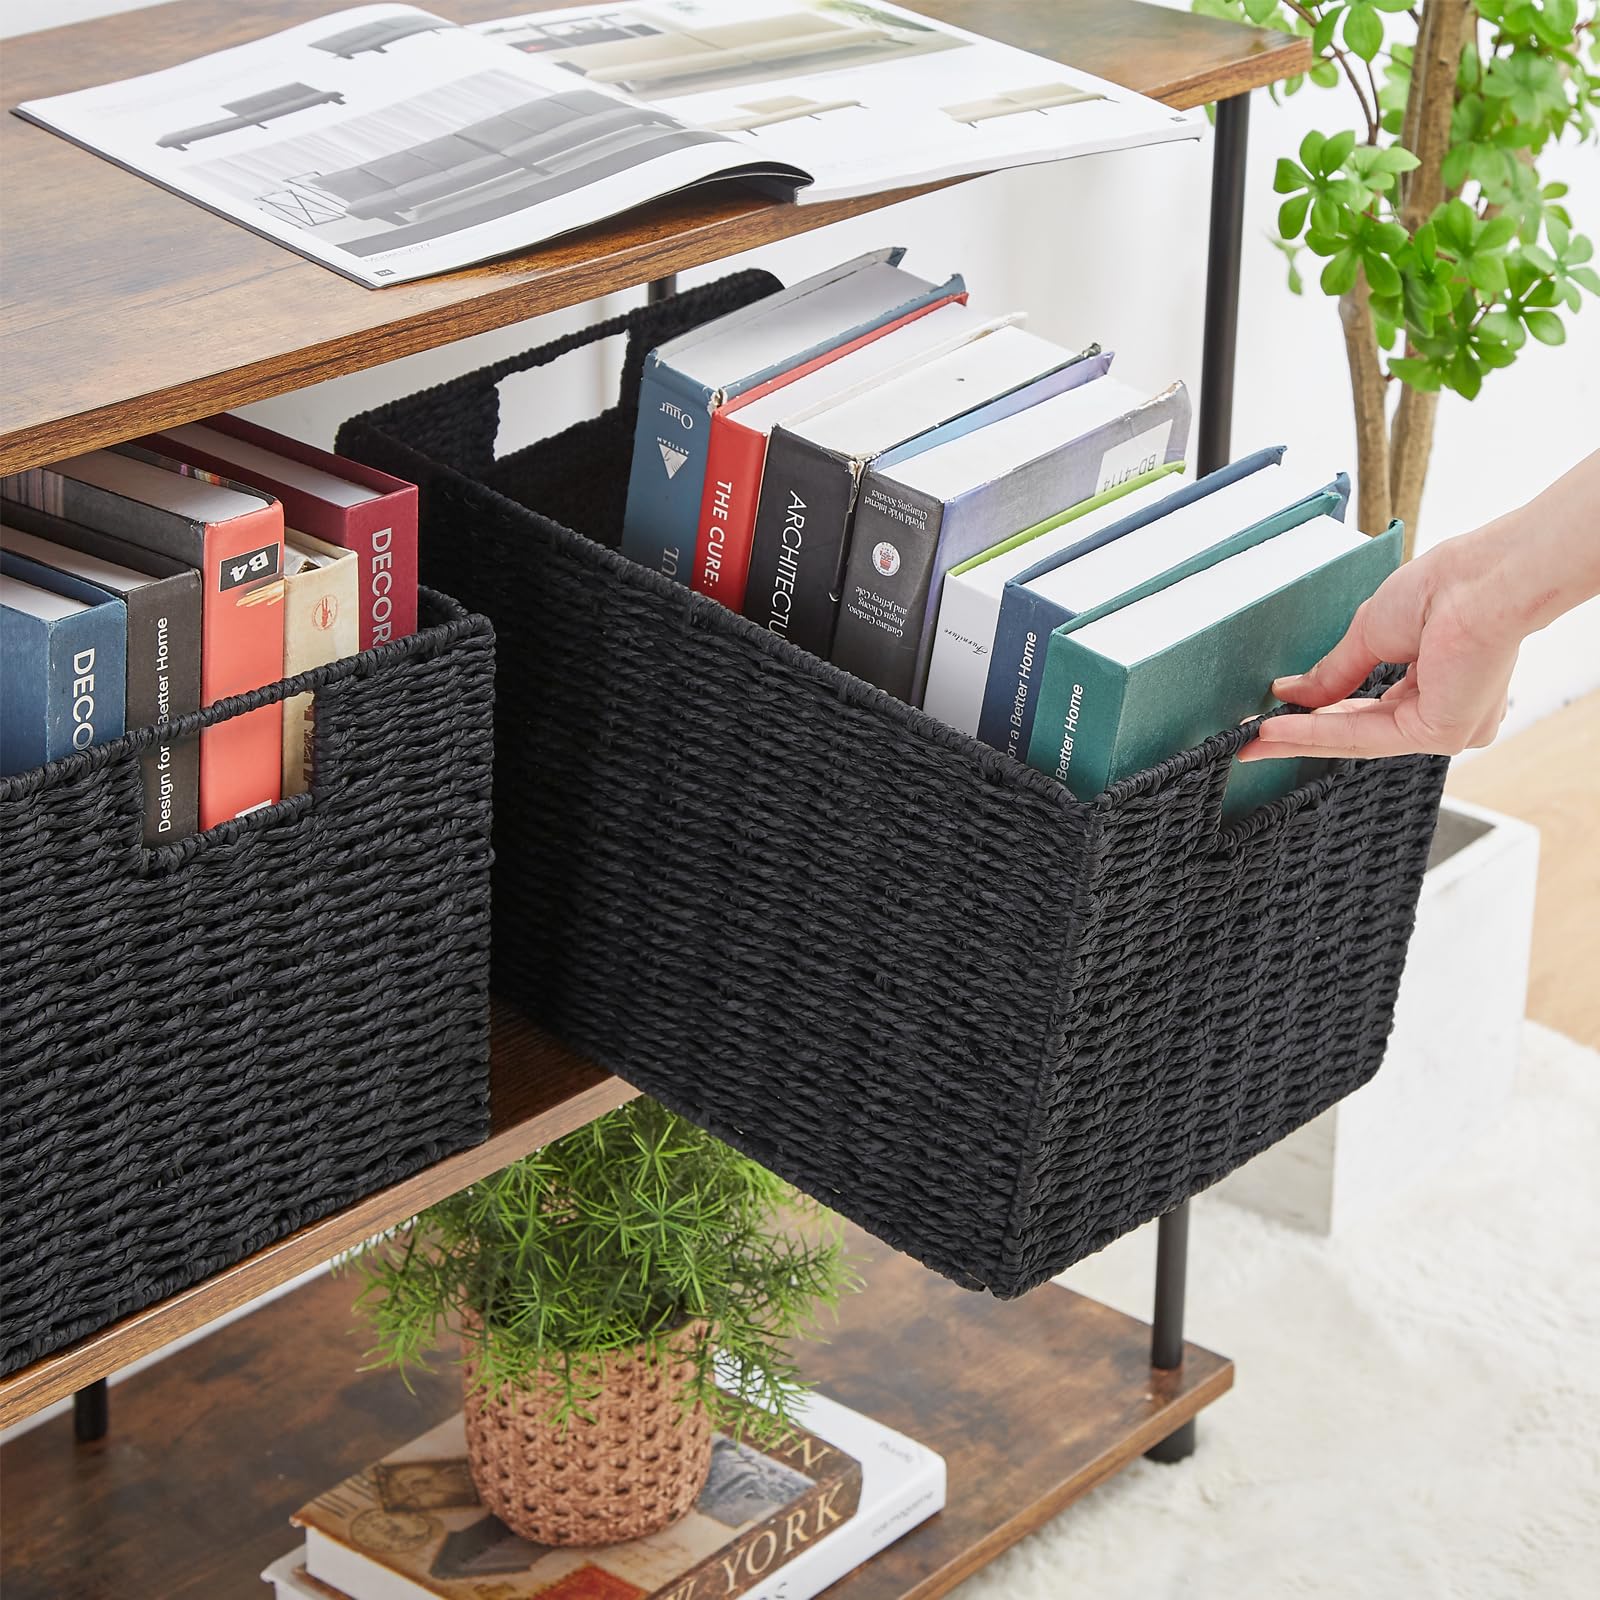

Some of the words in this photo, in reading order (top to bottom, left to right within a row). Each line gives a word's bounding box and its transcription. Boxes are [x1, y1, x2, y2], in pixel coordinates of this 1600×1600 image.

[660, 402, 693, 429] Ouur
[656, 436, 689, 455] ARTISAN
[713, 480, 732, 521] THE
[888, 507, 904, 522] Wide
[897, 499, 928, 521] Changing
[905, 514, 925, 530] World
[230, 551, 269, 582] B4
[703, 526, 725, 587] CURE:
[768, 489, 807, 639] ARCHITECTU
[372, 527, 393, 645] DECOR
[855, 586, 871, 600] Cole
[871, 592, 895, 611] Jeffrey
[893, 604, 908, 615] and
[875, 619, 903, 638] Gustavo
[883, 611, 905, 627] Angus
[156, 617, 169, 672] Home
[944, 628, 988, 655] Furniture
[1018, 631, 1038, 679] Home
[72, 647, 96, 750] DECO
[157, 674, 169, 724] Better
[1010, 679, 1029, 728] Better
[1064, 684, 1084, 732] Home
[1010, 729, 1020, 740] a
[158, 746, 171, 770] for
[1007, 741, 1017, 759] or
[1055, 733, 1075, 781] Better
[158, 772, 174, 833] Design
[721, 1482, 845, 1594] YORK
